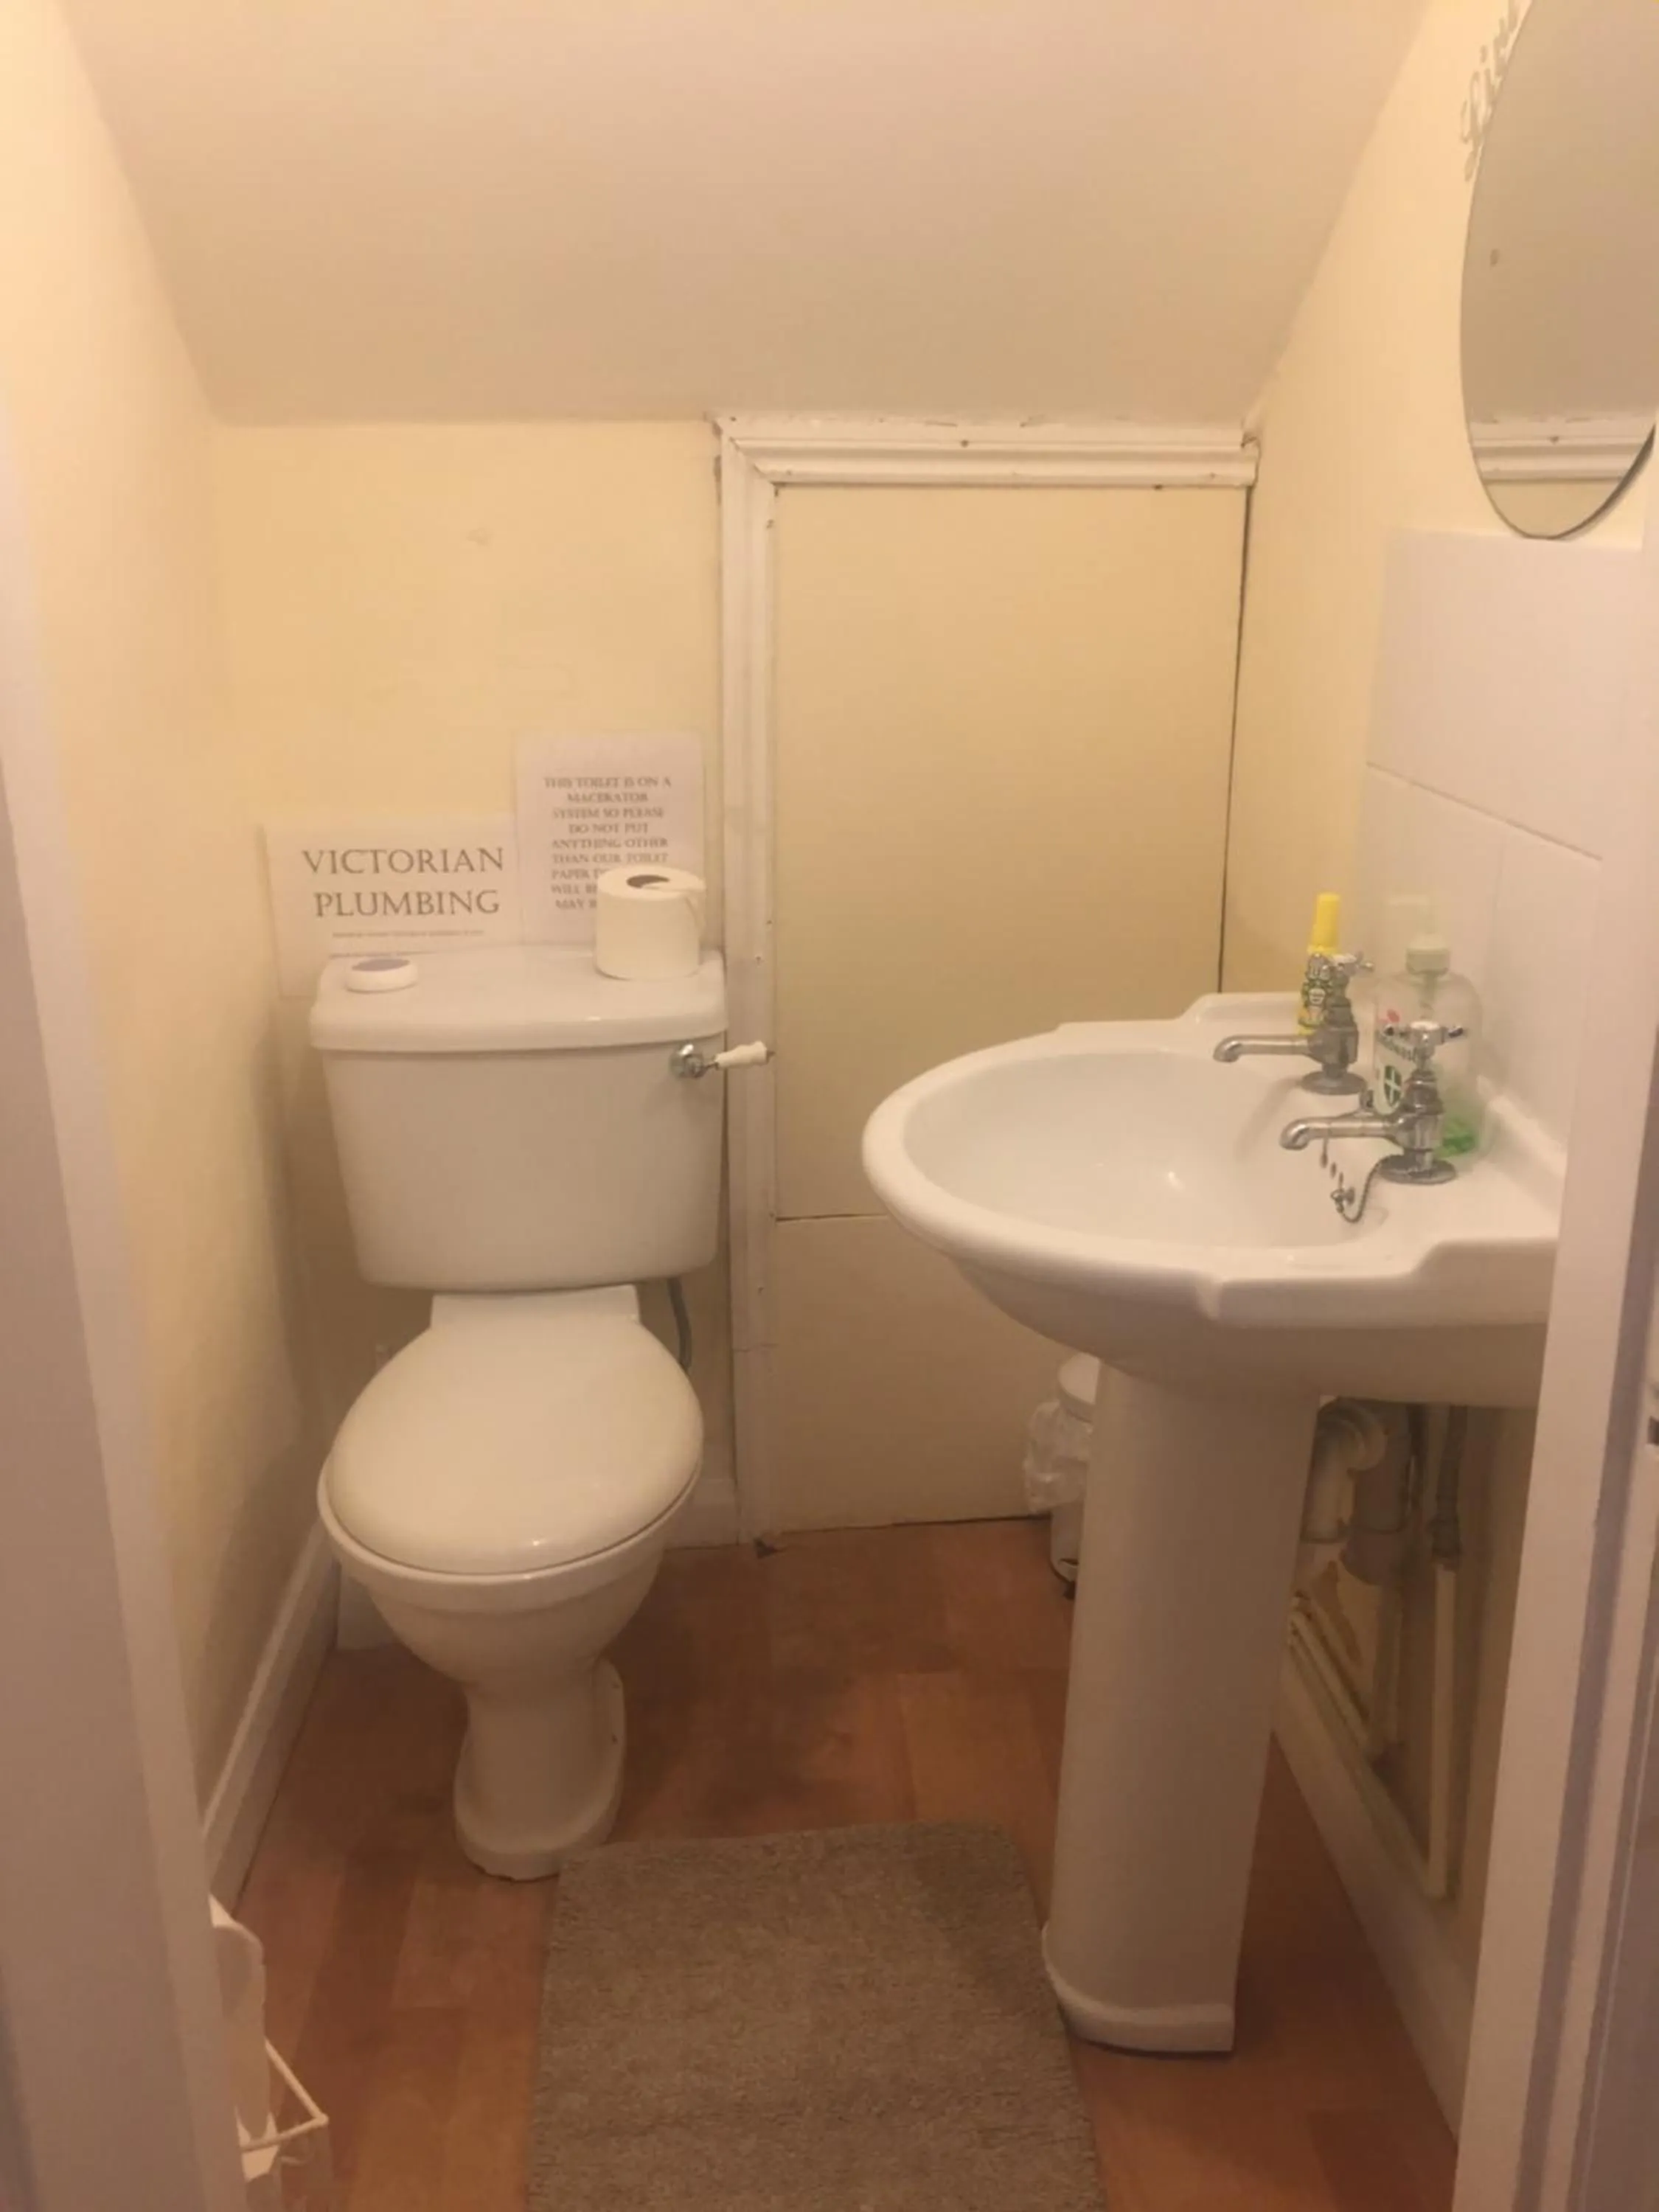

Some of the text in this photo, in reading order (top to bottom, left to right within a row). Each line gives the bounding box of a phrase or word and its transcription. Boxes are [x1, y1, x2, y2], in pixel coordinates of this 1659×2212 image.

[543, 776, 672, 788] THIS TOILET IS ON A
[567, 792, 648, 803] MACERATOR
[553, 807, 664, 818] SYSTEM SO PLEASE
[568, 823, 648, 834] DO NOT PUT
[552, 837, 669, 849] ANYTHING OTHER
[302, 847, 504, 874] VICTORIAN
[552, 852, 669, 863] THAN OUR TOILET
[552, 869, 589, 880] PAPER
[551, 884, 580, 895] WILL
[314, 888, 500, 917] PLUMBING
[555, 899, 584, 910] MAY
